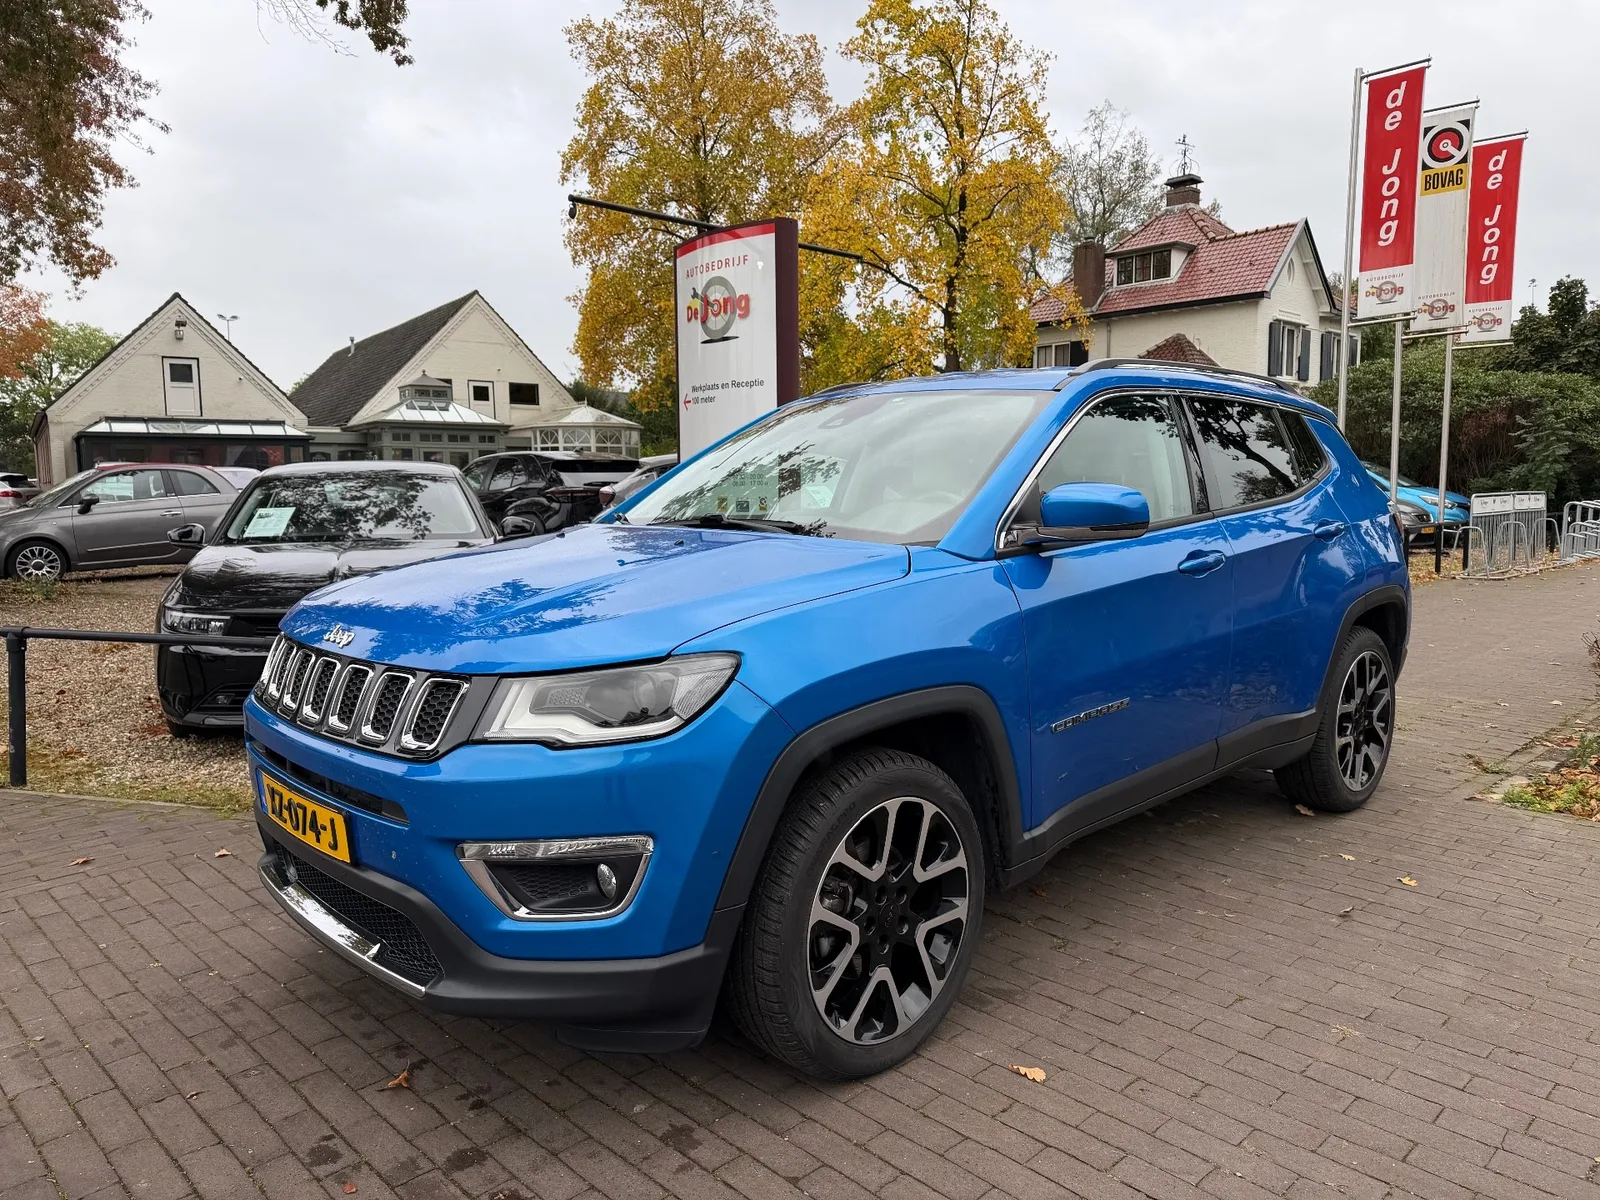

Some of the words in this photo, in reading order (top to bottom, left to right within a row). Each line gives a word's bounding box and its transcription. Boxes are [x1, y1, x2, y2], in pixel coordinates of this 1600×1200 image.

[1385, 80, 1407, 131] de
[1424, 168, 1464, 191] BOVAG
[1486, 149, 1508, 190] de
[1378, 148, 1402, 246] Jong
[1480, 204, 1502, 285] Jong
[686, 254, 749, 279] AUTOBEDRIJF
[1366, 273, 1404, 282] AUTOBEDRIJF
[691, 382, 720, 393] Werkplaats
[731, 378, 765, 389] Receptie
[692, 396, 700, 405] 100
[700, 395, 716, 404] meter
[323, 624, 355, 648] Jeep
[1050, 697, 1130, 733] COMPASS
